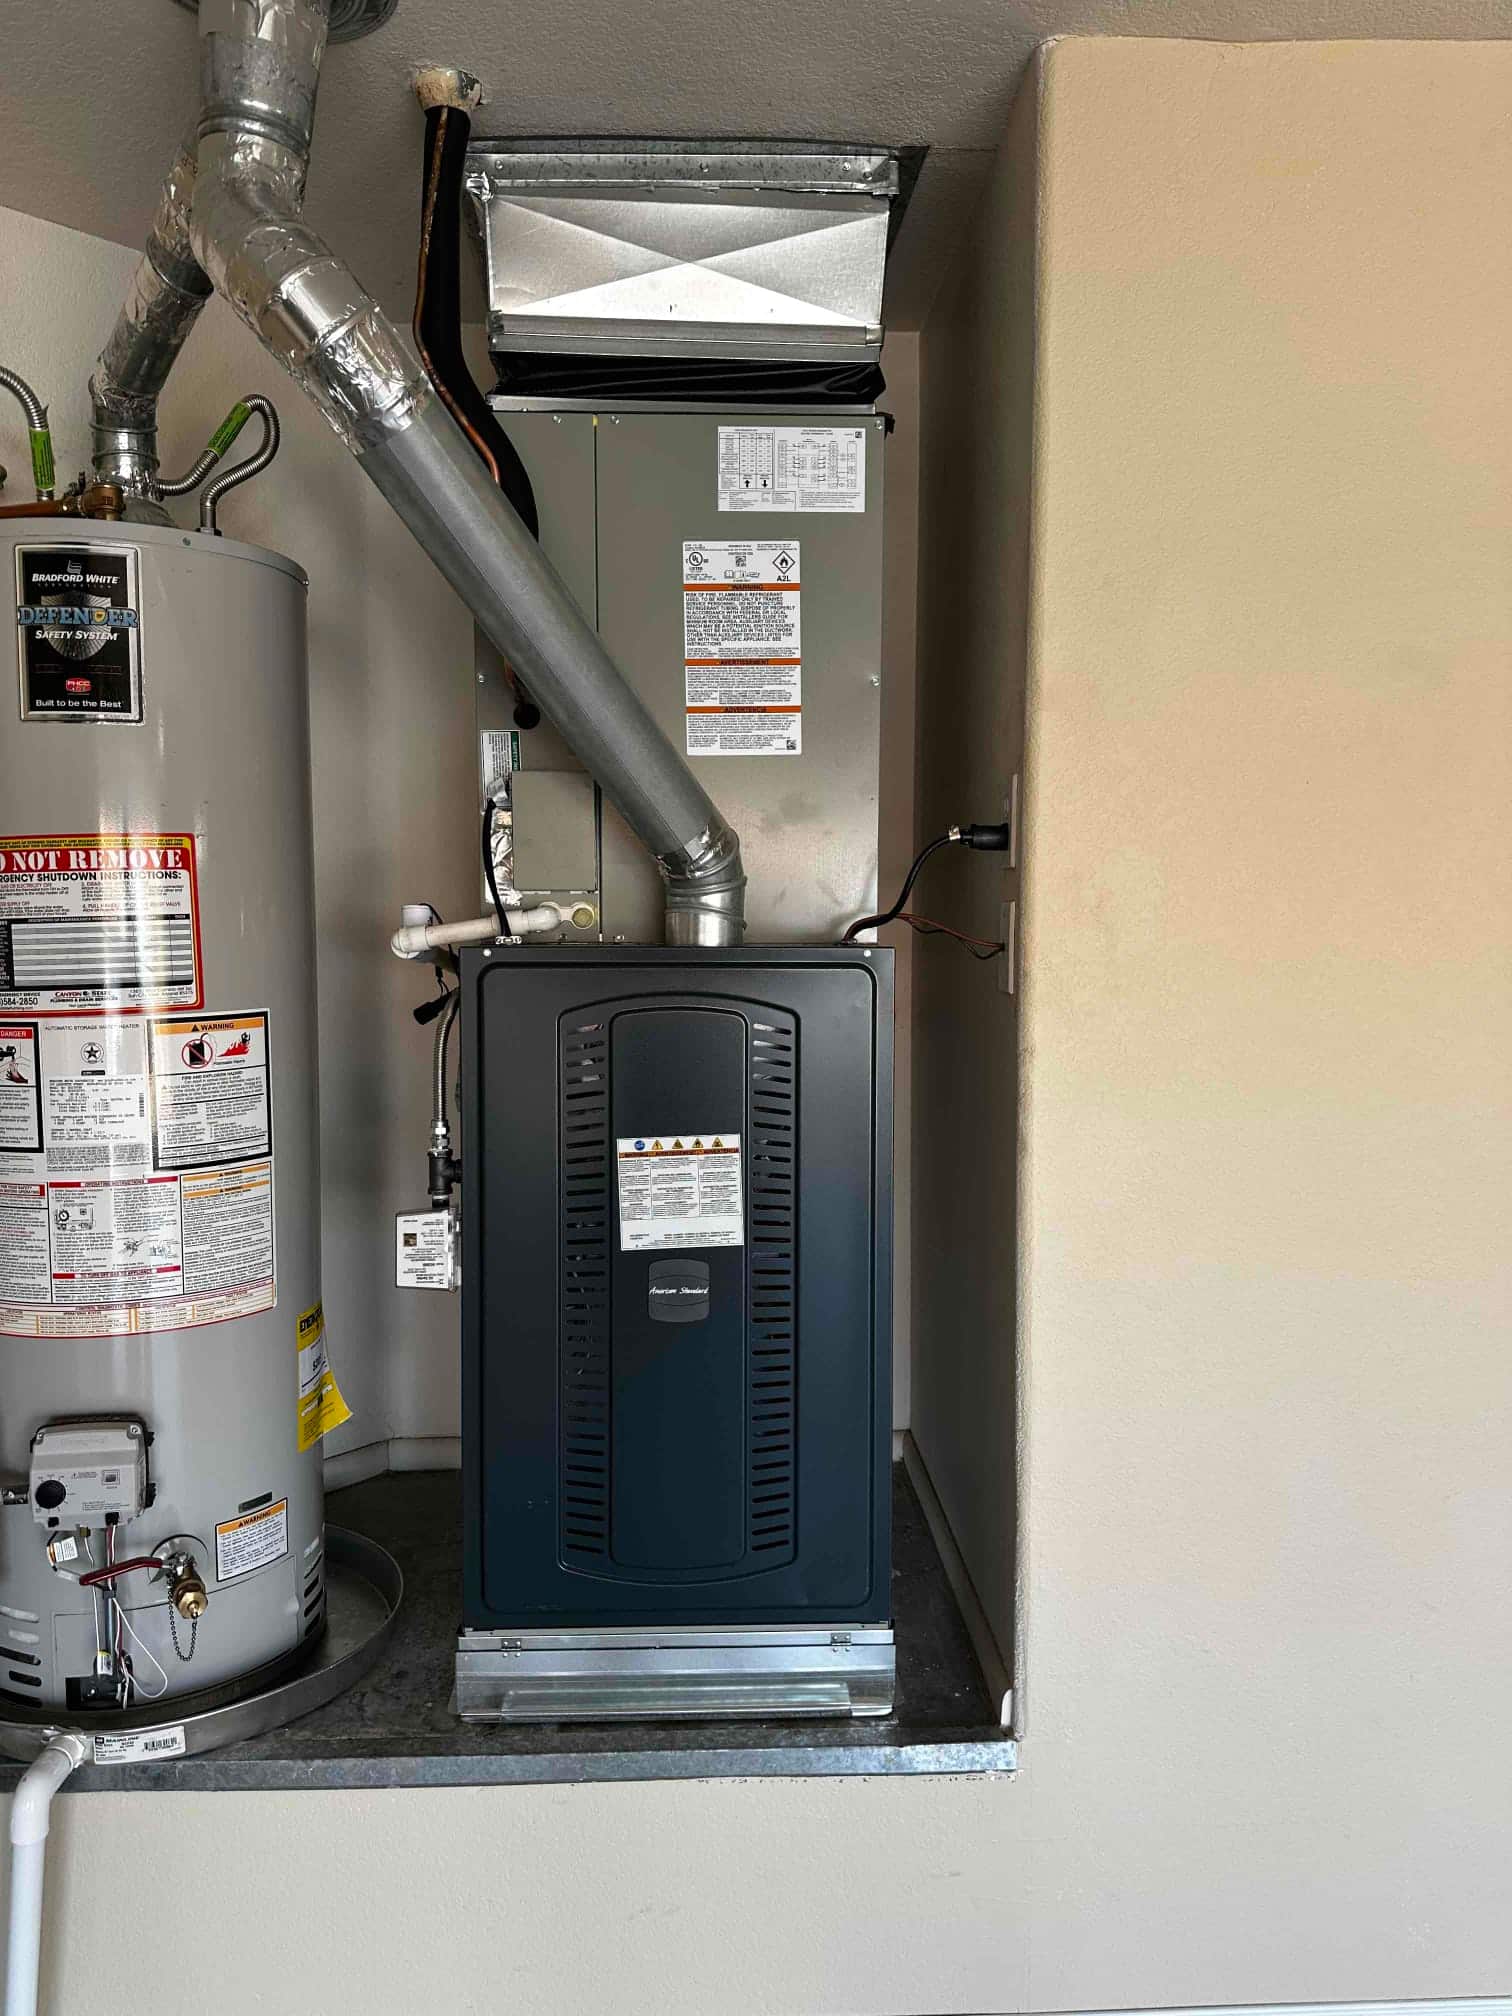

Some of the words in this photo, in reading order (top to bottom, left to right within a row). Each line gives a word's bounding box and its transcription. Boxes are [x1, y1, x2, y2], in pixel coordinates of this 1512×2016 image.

[32, 573, 83, 583] BRADFORD
[86, 574, 119, 584] WHITE
[19, 606, 138, 628] DEFENDER
[35, 630, 72, 640] SAFETY
[75, 630, 118, 641] SYSTEM
[36, 699, 54, 707] Built
[12, 850, 61, 871] NOT
[68, 850, 182, 870] REMOVE
[37, 872, 96, 882] SHUTDOWN
[100, 871, 182, 880] INSTRUCTIONS:
[0, 998, 38, 1006] )584-2850
[201, 1023, 234, 1031] WARNING
[246, 1510, 272, 1524] WARNING
